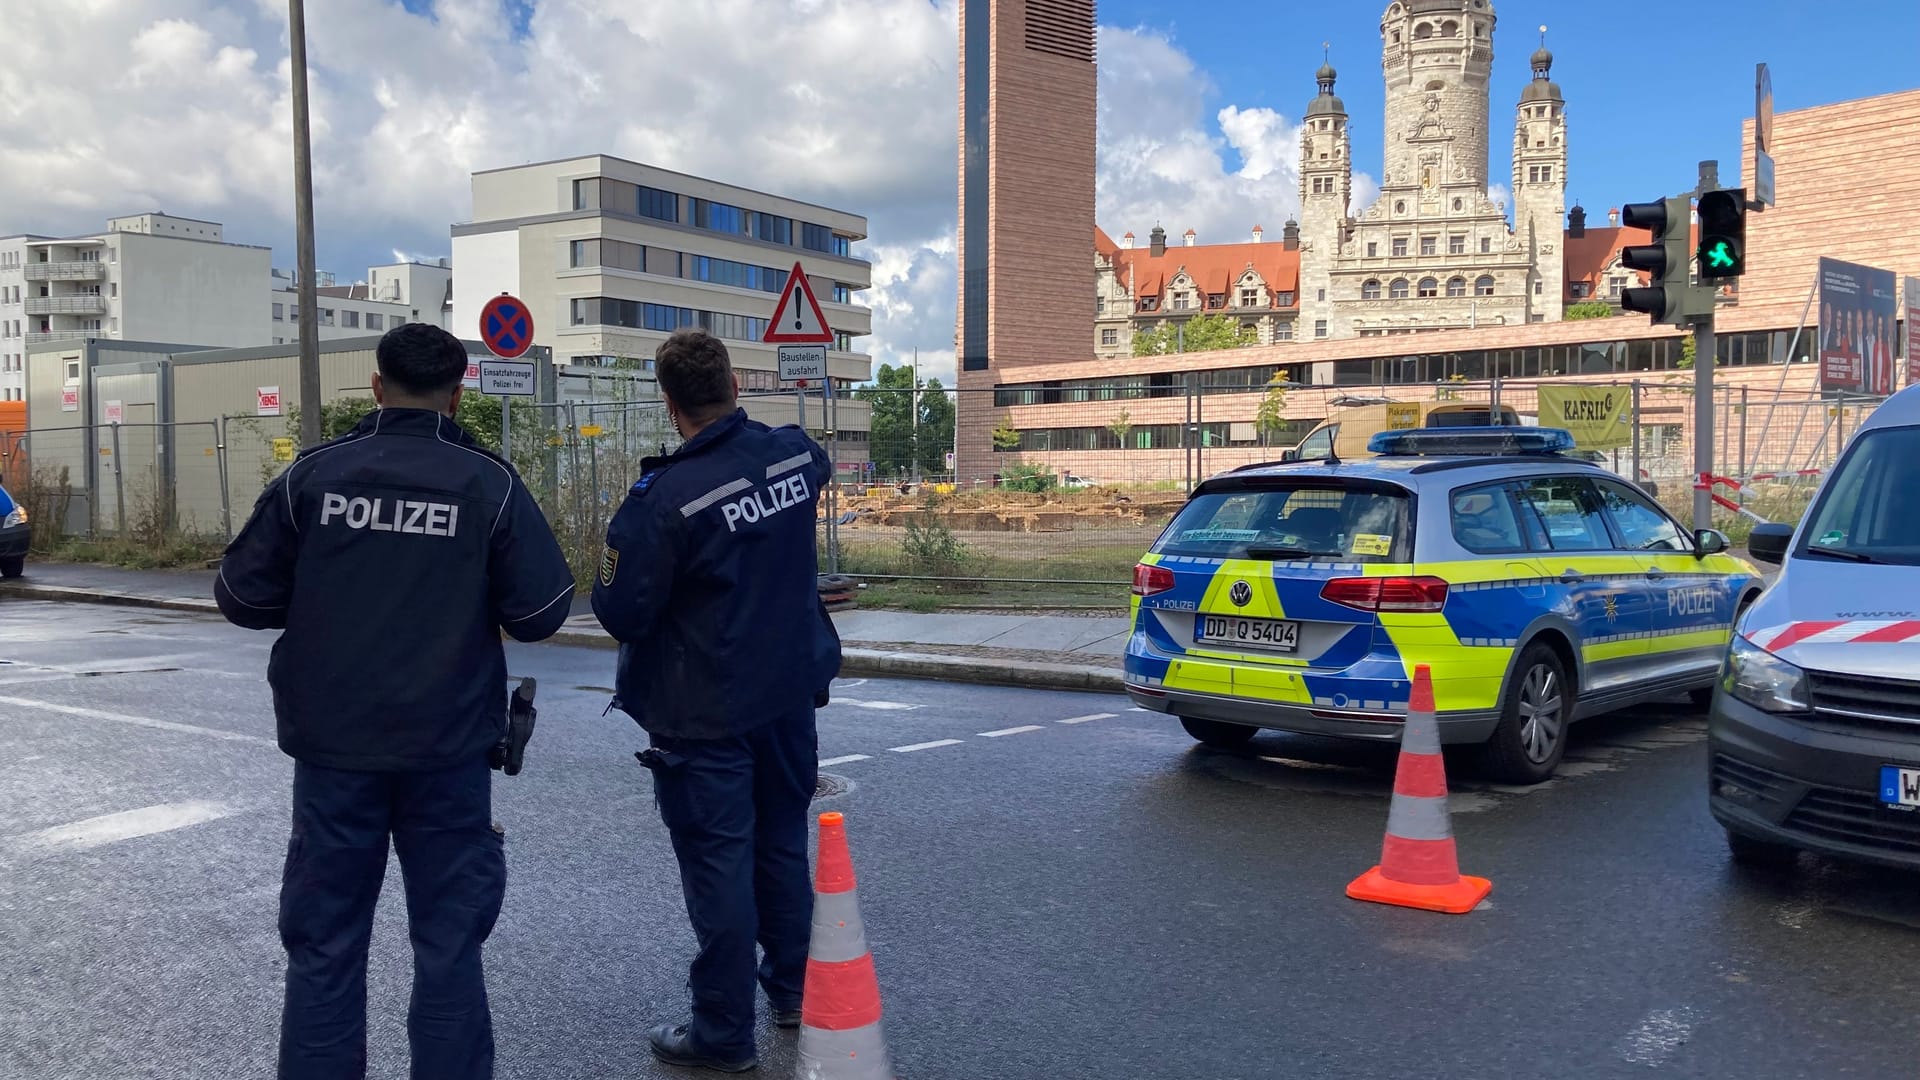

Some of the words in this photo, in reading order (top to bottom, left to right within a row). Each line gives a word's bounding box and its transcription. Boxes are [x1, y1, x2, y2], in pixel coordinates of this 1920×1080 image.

[780, 352, 824, 362] Baustellen-
[483, 367, 532, 379] Einsatzfahrzeuge
[787, 365, 818, 376] ausfahrt
[492, 379, 512, 388] Polizei
[513, 380, 524, 389] frei
[1563, 400, 1607, 421] KAFRIL
[720, 472, 811, 533] POLIZEI
[319, 492, 459, 537] POLIZEI
[1163, 599, 1196, 610] POLIZEI
[1667, 587, 1716, 617] POLIZEI
[1205, 617, 1227, 637] DD
[1237, 620, 1249, 640] Q
[1251, 621, 1295, 644] 5404
